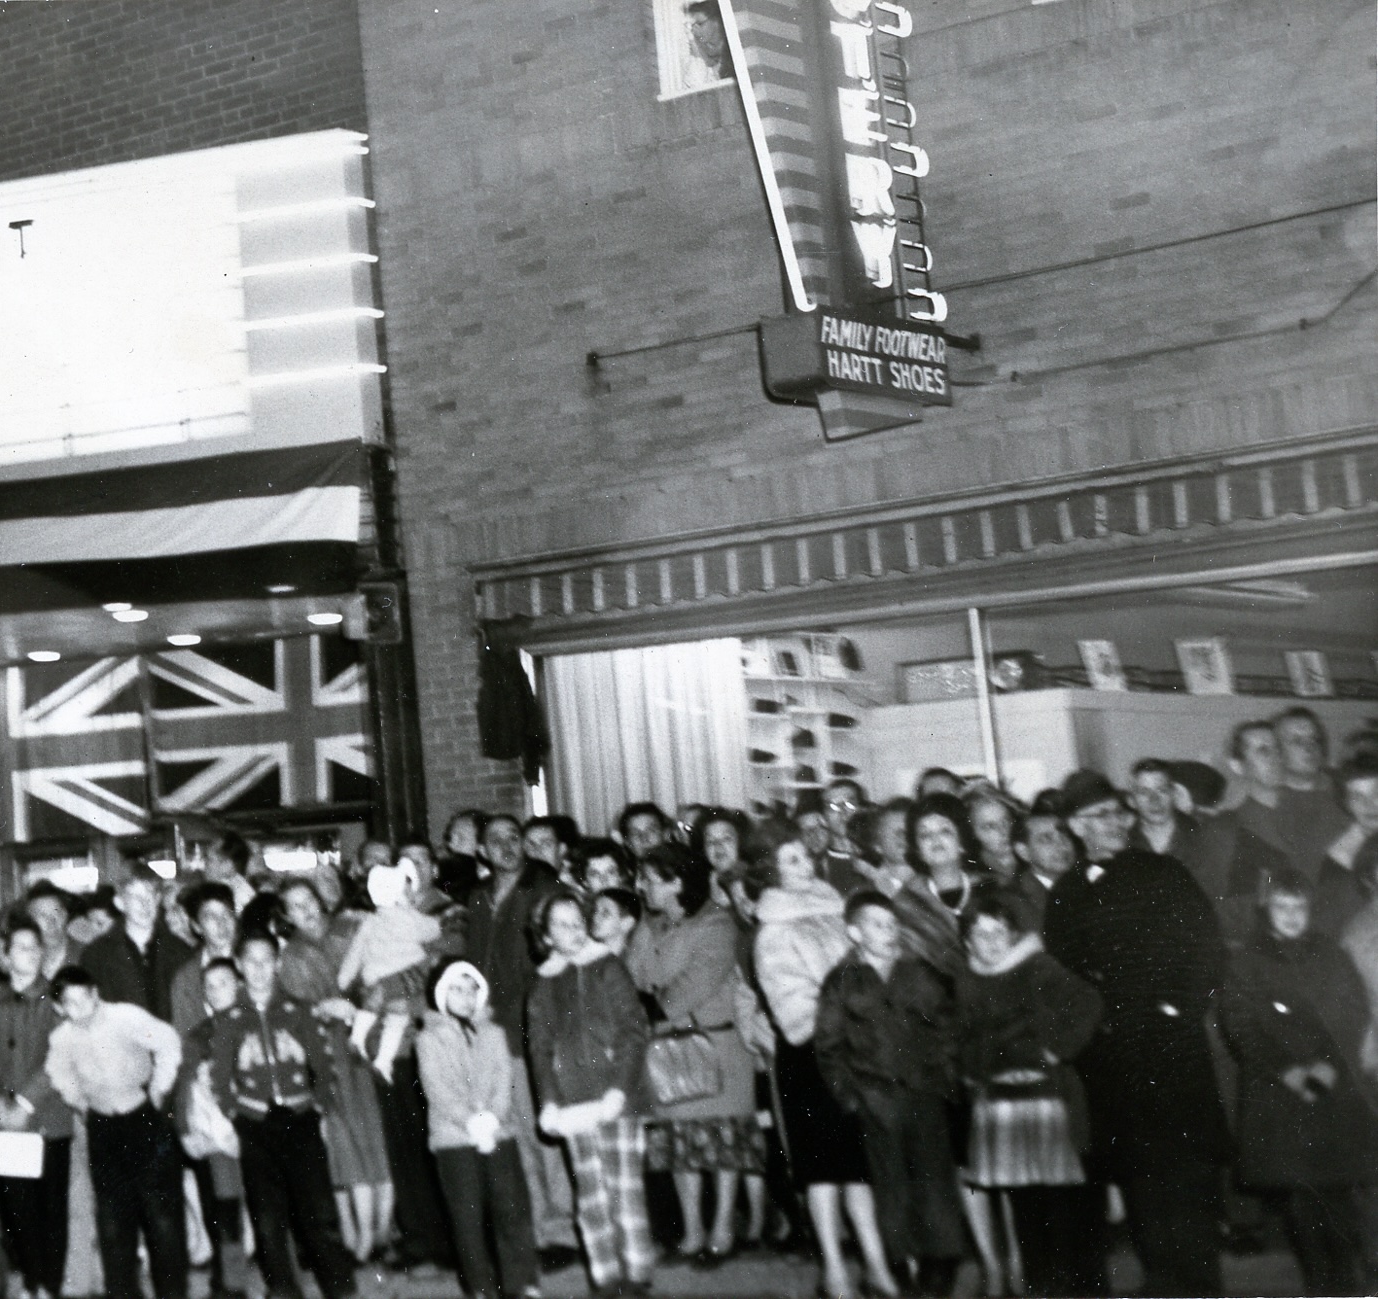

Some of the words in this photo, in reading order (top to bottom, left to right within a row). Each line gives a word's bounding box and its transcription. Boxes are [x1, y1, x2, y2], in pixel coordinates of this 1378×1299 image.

[821, 314, 875, 353] FAMILY
[874, 325, 947, 365] FOOTWEAR
[826, 348, 884, 385] HARTT
[888, 360, 946, 395] SHOES
